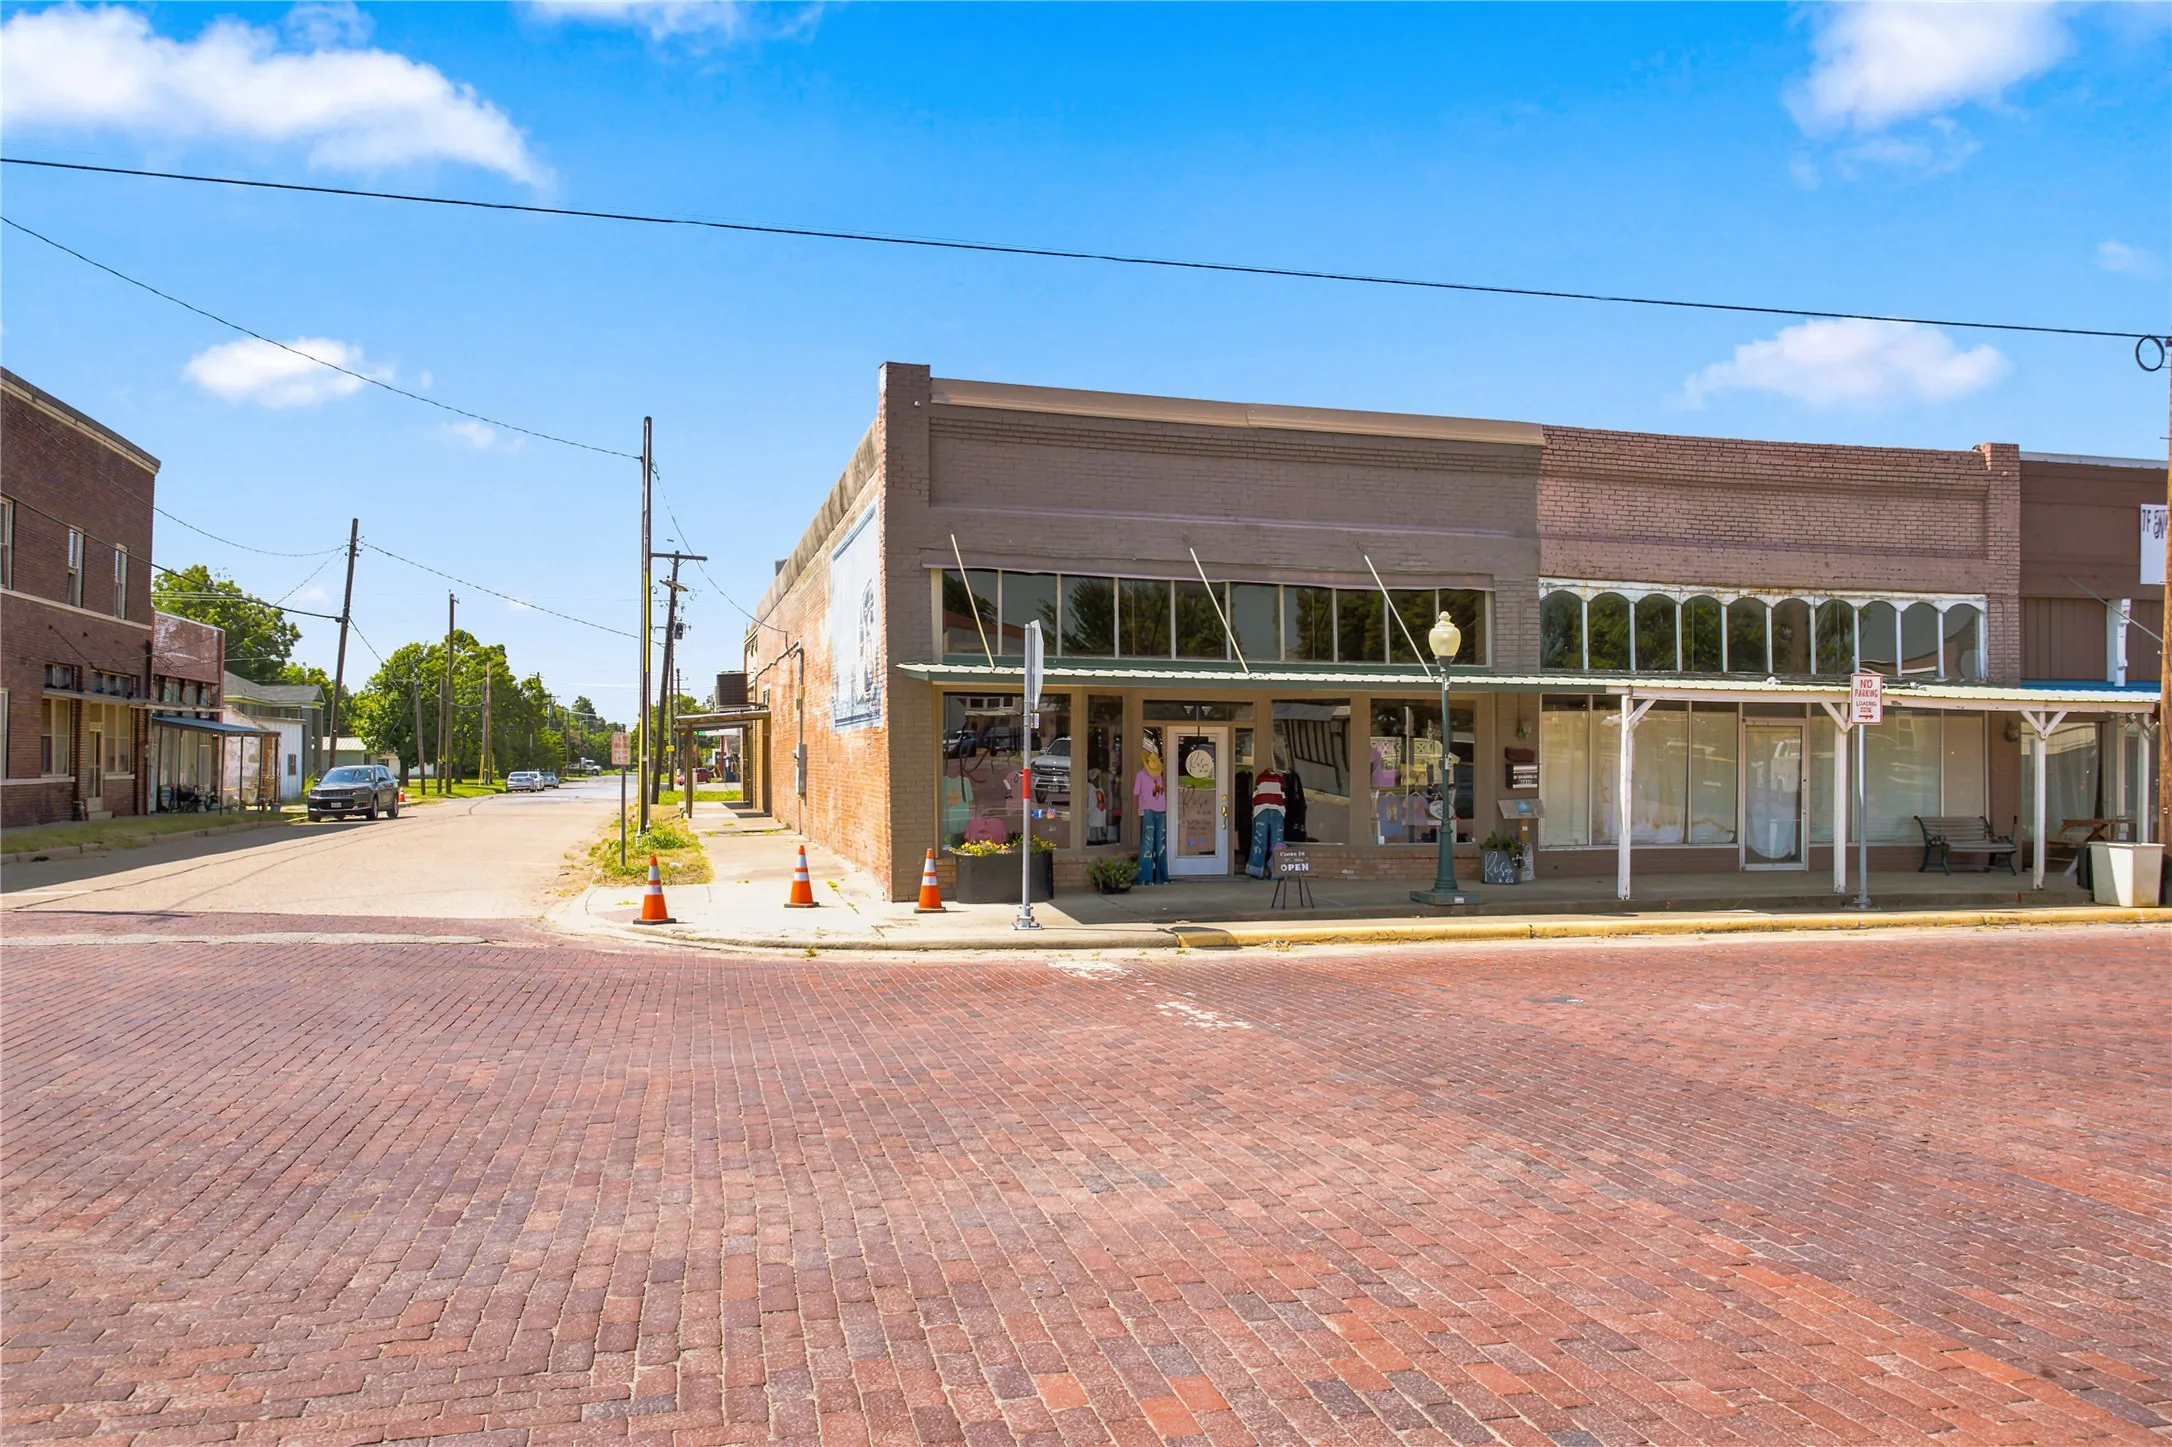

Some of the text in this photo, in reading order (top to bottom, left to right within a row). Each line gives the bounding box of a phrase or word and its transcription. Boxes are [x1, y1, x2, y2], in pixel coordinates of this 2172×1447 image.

[1860, 679, 1873, 688] NO
[1854, 689, 1878, 698] PARKING
[1280, 863, 1309, 872] OPEN
